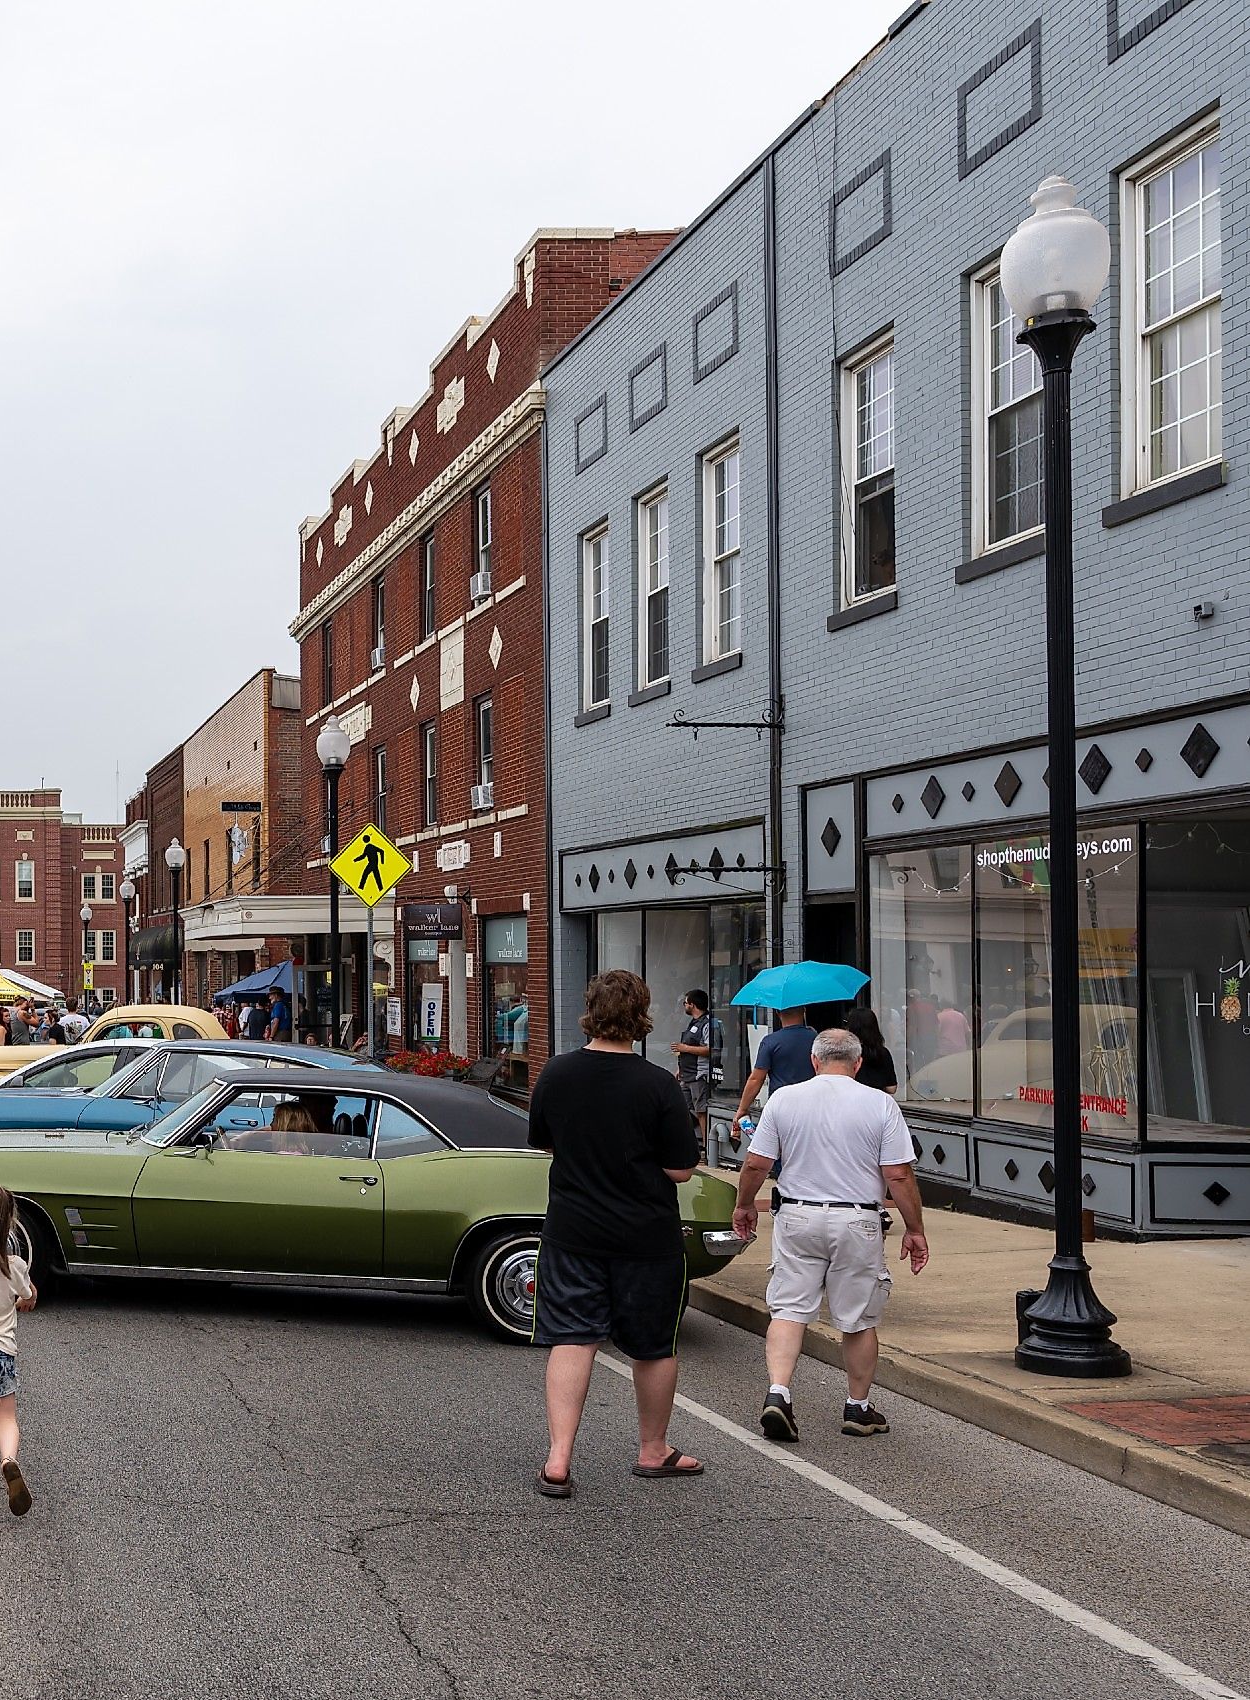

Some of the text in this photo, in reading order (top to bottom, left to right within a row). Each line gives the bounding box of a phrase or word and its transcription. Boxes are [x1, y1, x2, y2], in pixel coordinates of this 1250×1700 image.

[498, 948, 513, 958] walker
[152, 963, 164, 971] 104
[426, 1001, 437, 1036] OPEN
[1019, 1086, 1054, 1106] PARKING
